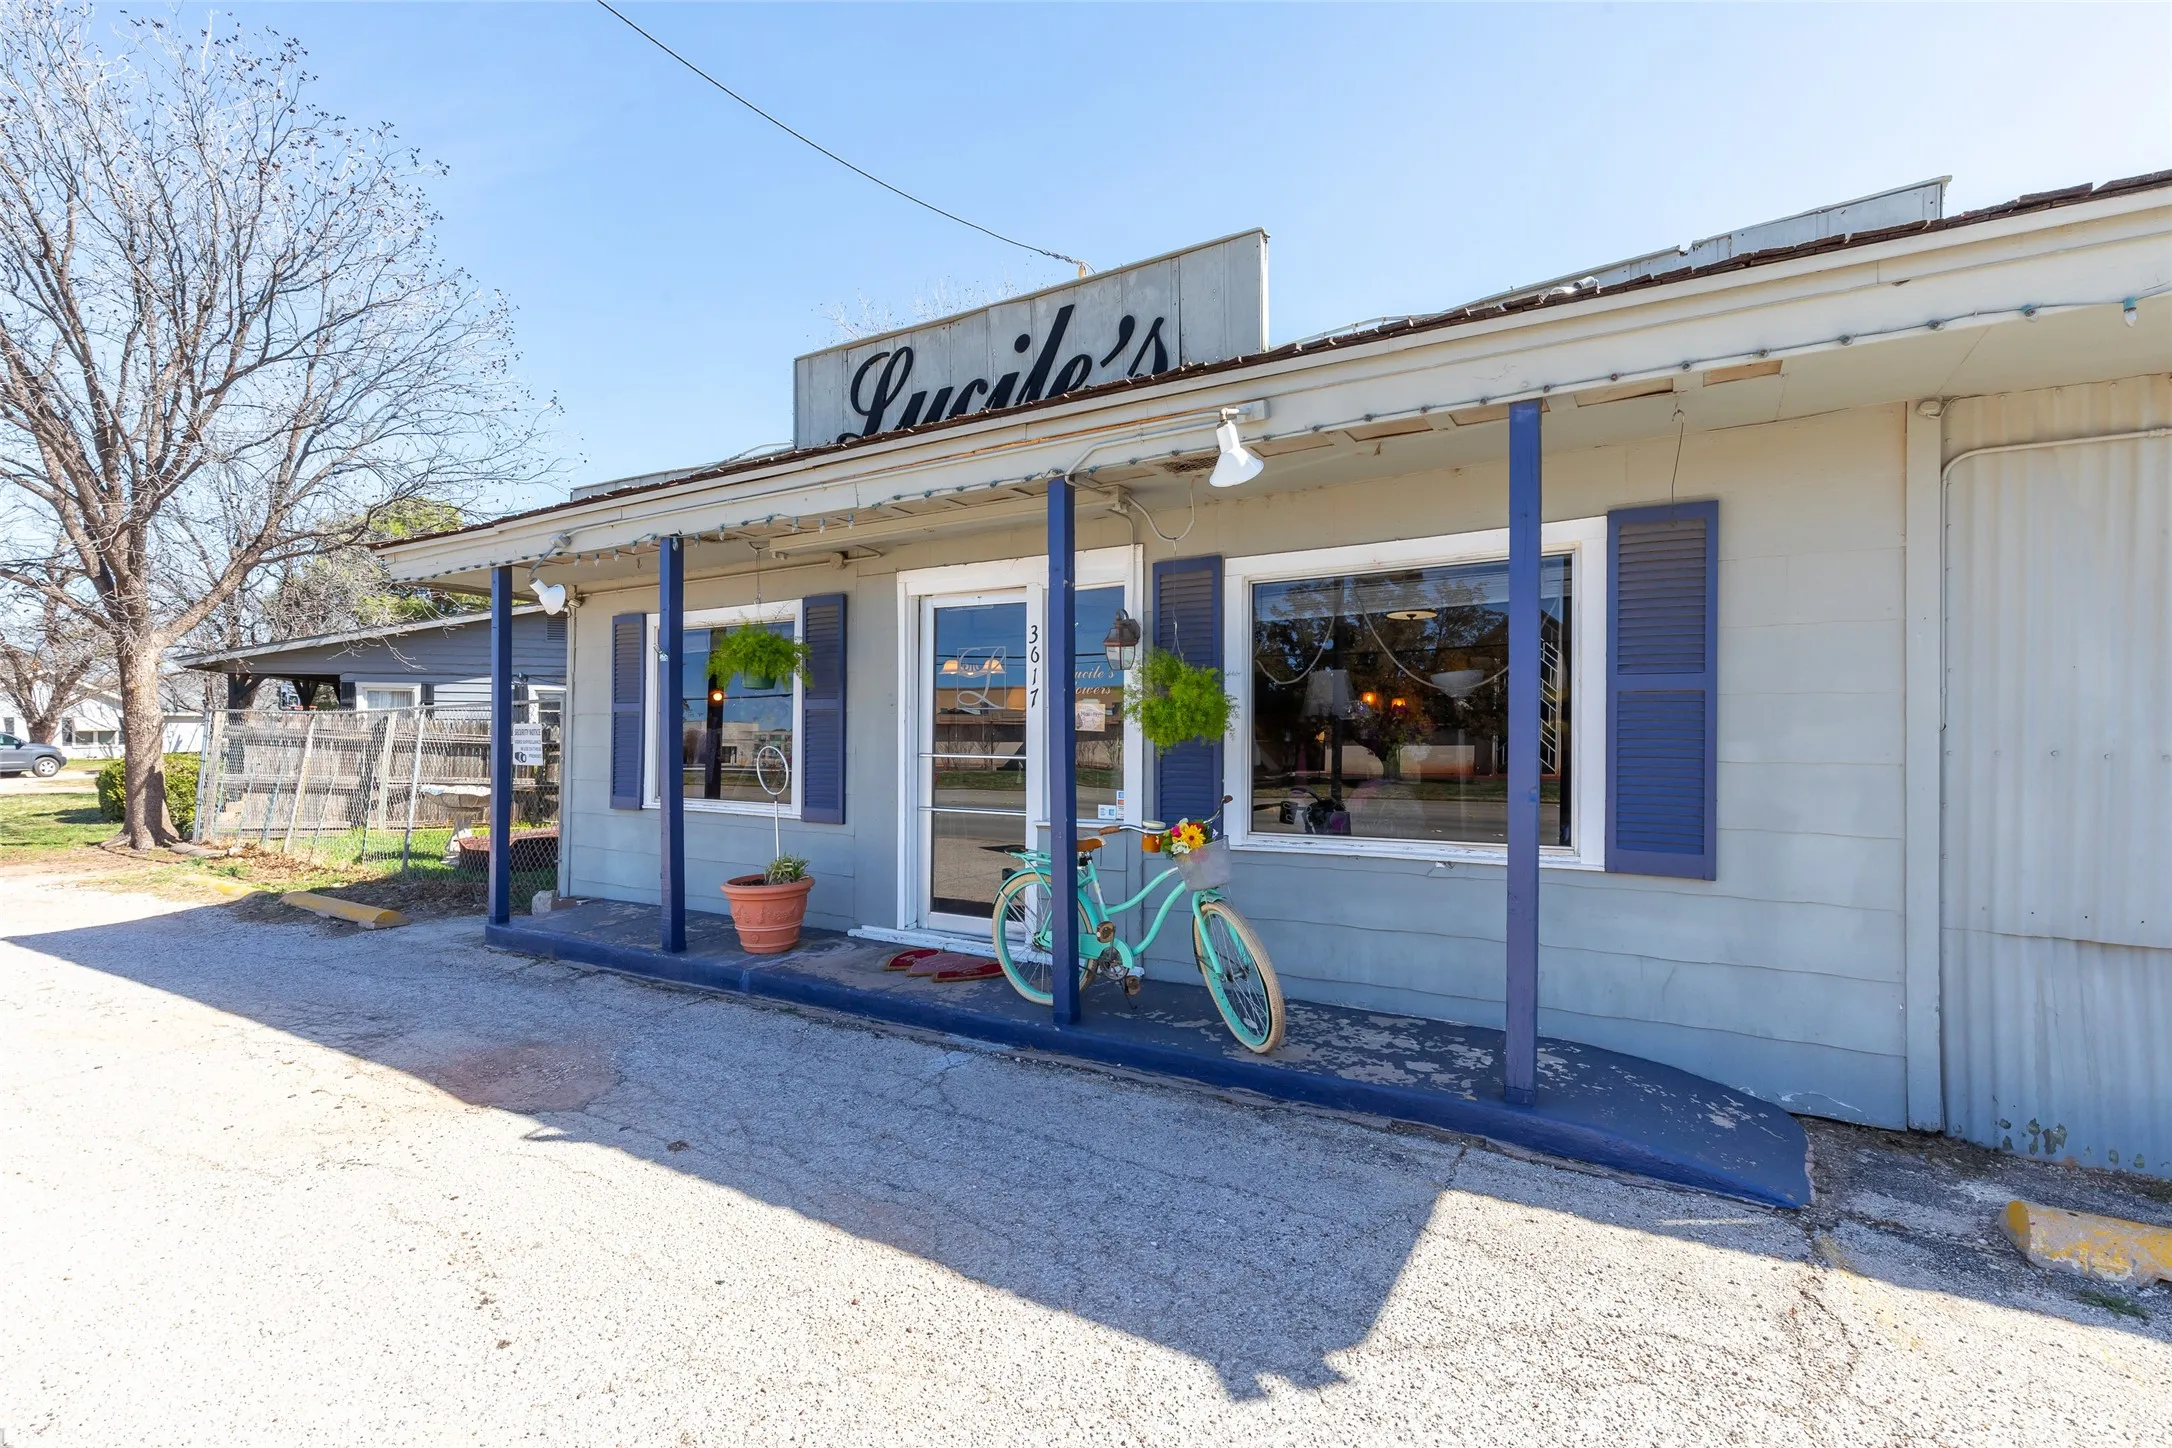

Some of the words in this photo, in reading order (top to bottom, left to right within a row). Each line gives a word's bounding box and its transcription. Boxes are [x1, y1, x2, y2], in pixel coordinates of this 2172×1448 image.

[837, 304, 1168, 444] Lucile's
[1028, 625, 1040, 708] 3617
[1075, 665, 1114, 679] uciles
[1075, 682, 1111, 695] owers
